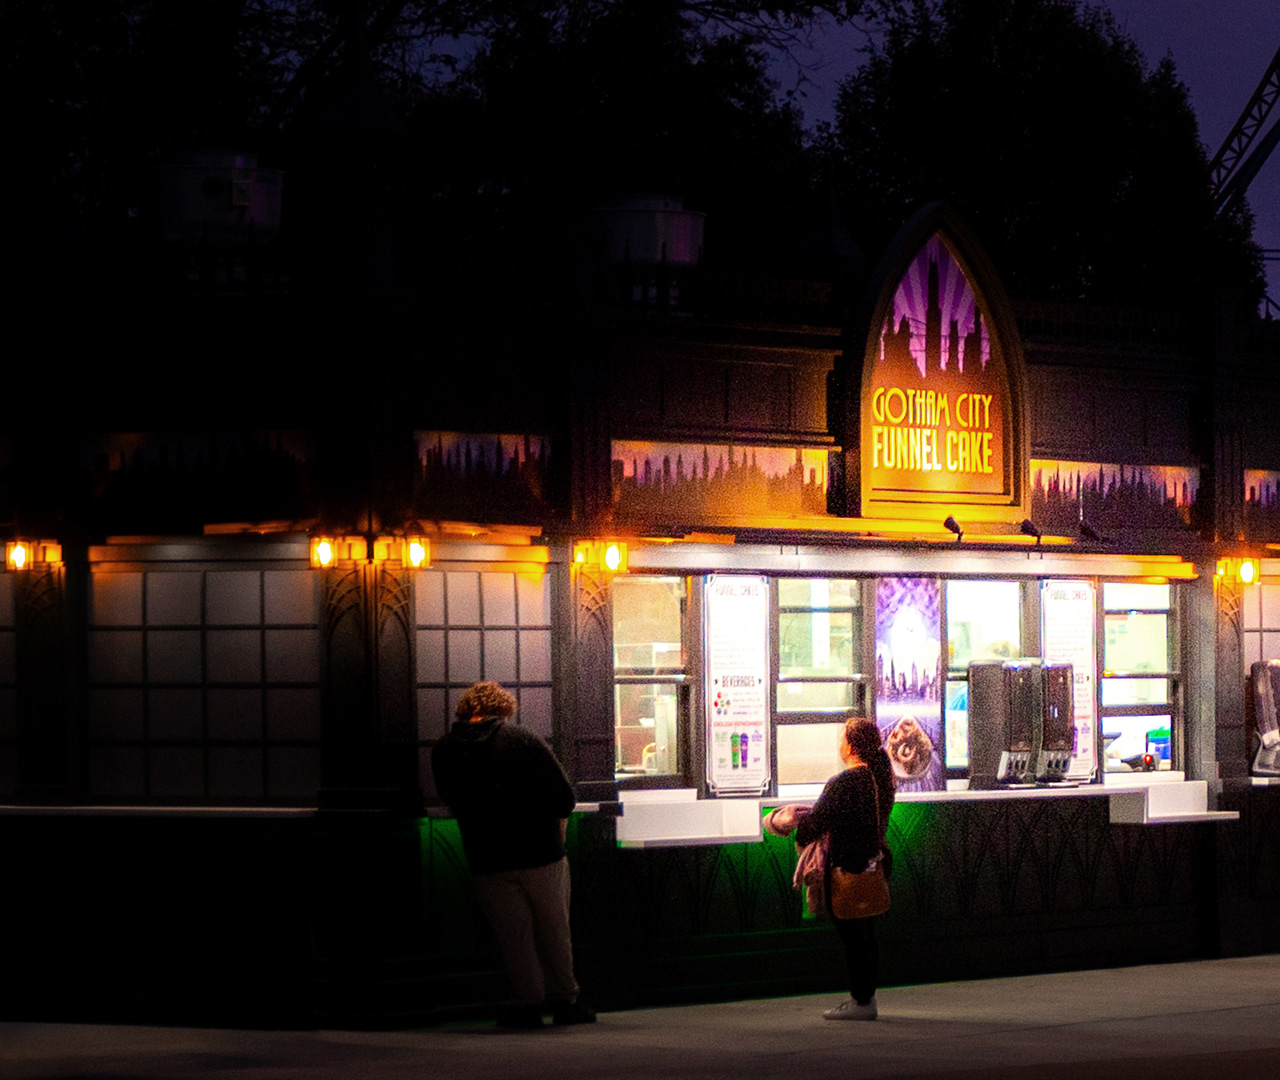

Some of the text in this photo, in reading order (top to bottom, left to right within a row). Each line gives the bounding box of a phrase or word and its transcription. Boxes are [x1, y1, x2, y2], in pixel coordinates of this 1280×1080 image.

[872, 387, 993, 428] GOTHAM CITY
[872, 425, 993, 473] FUNNEL CAKE
[721, 675, 755, 688] BEVERAGES
